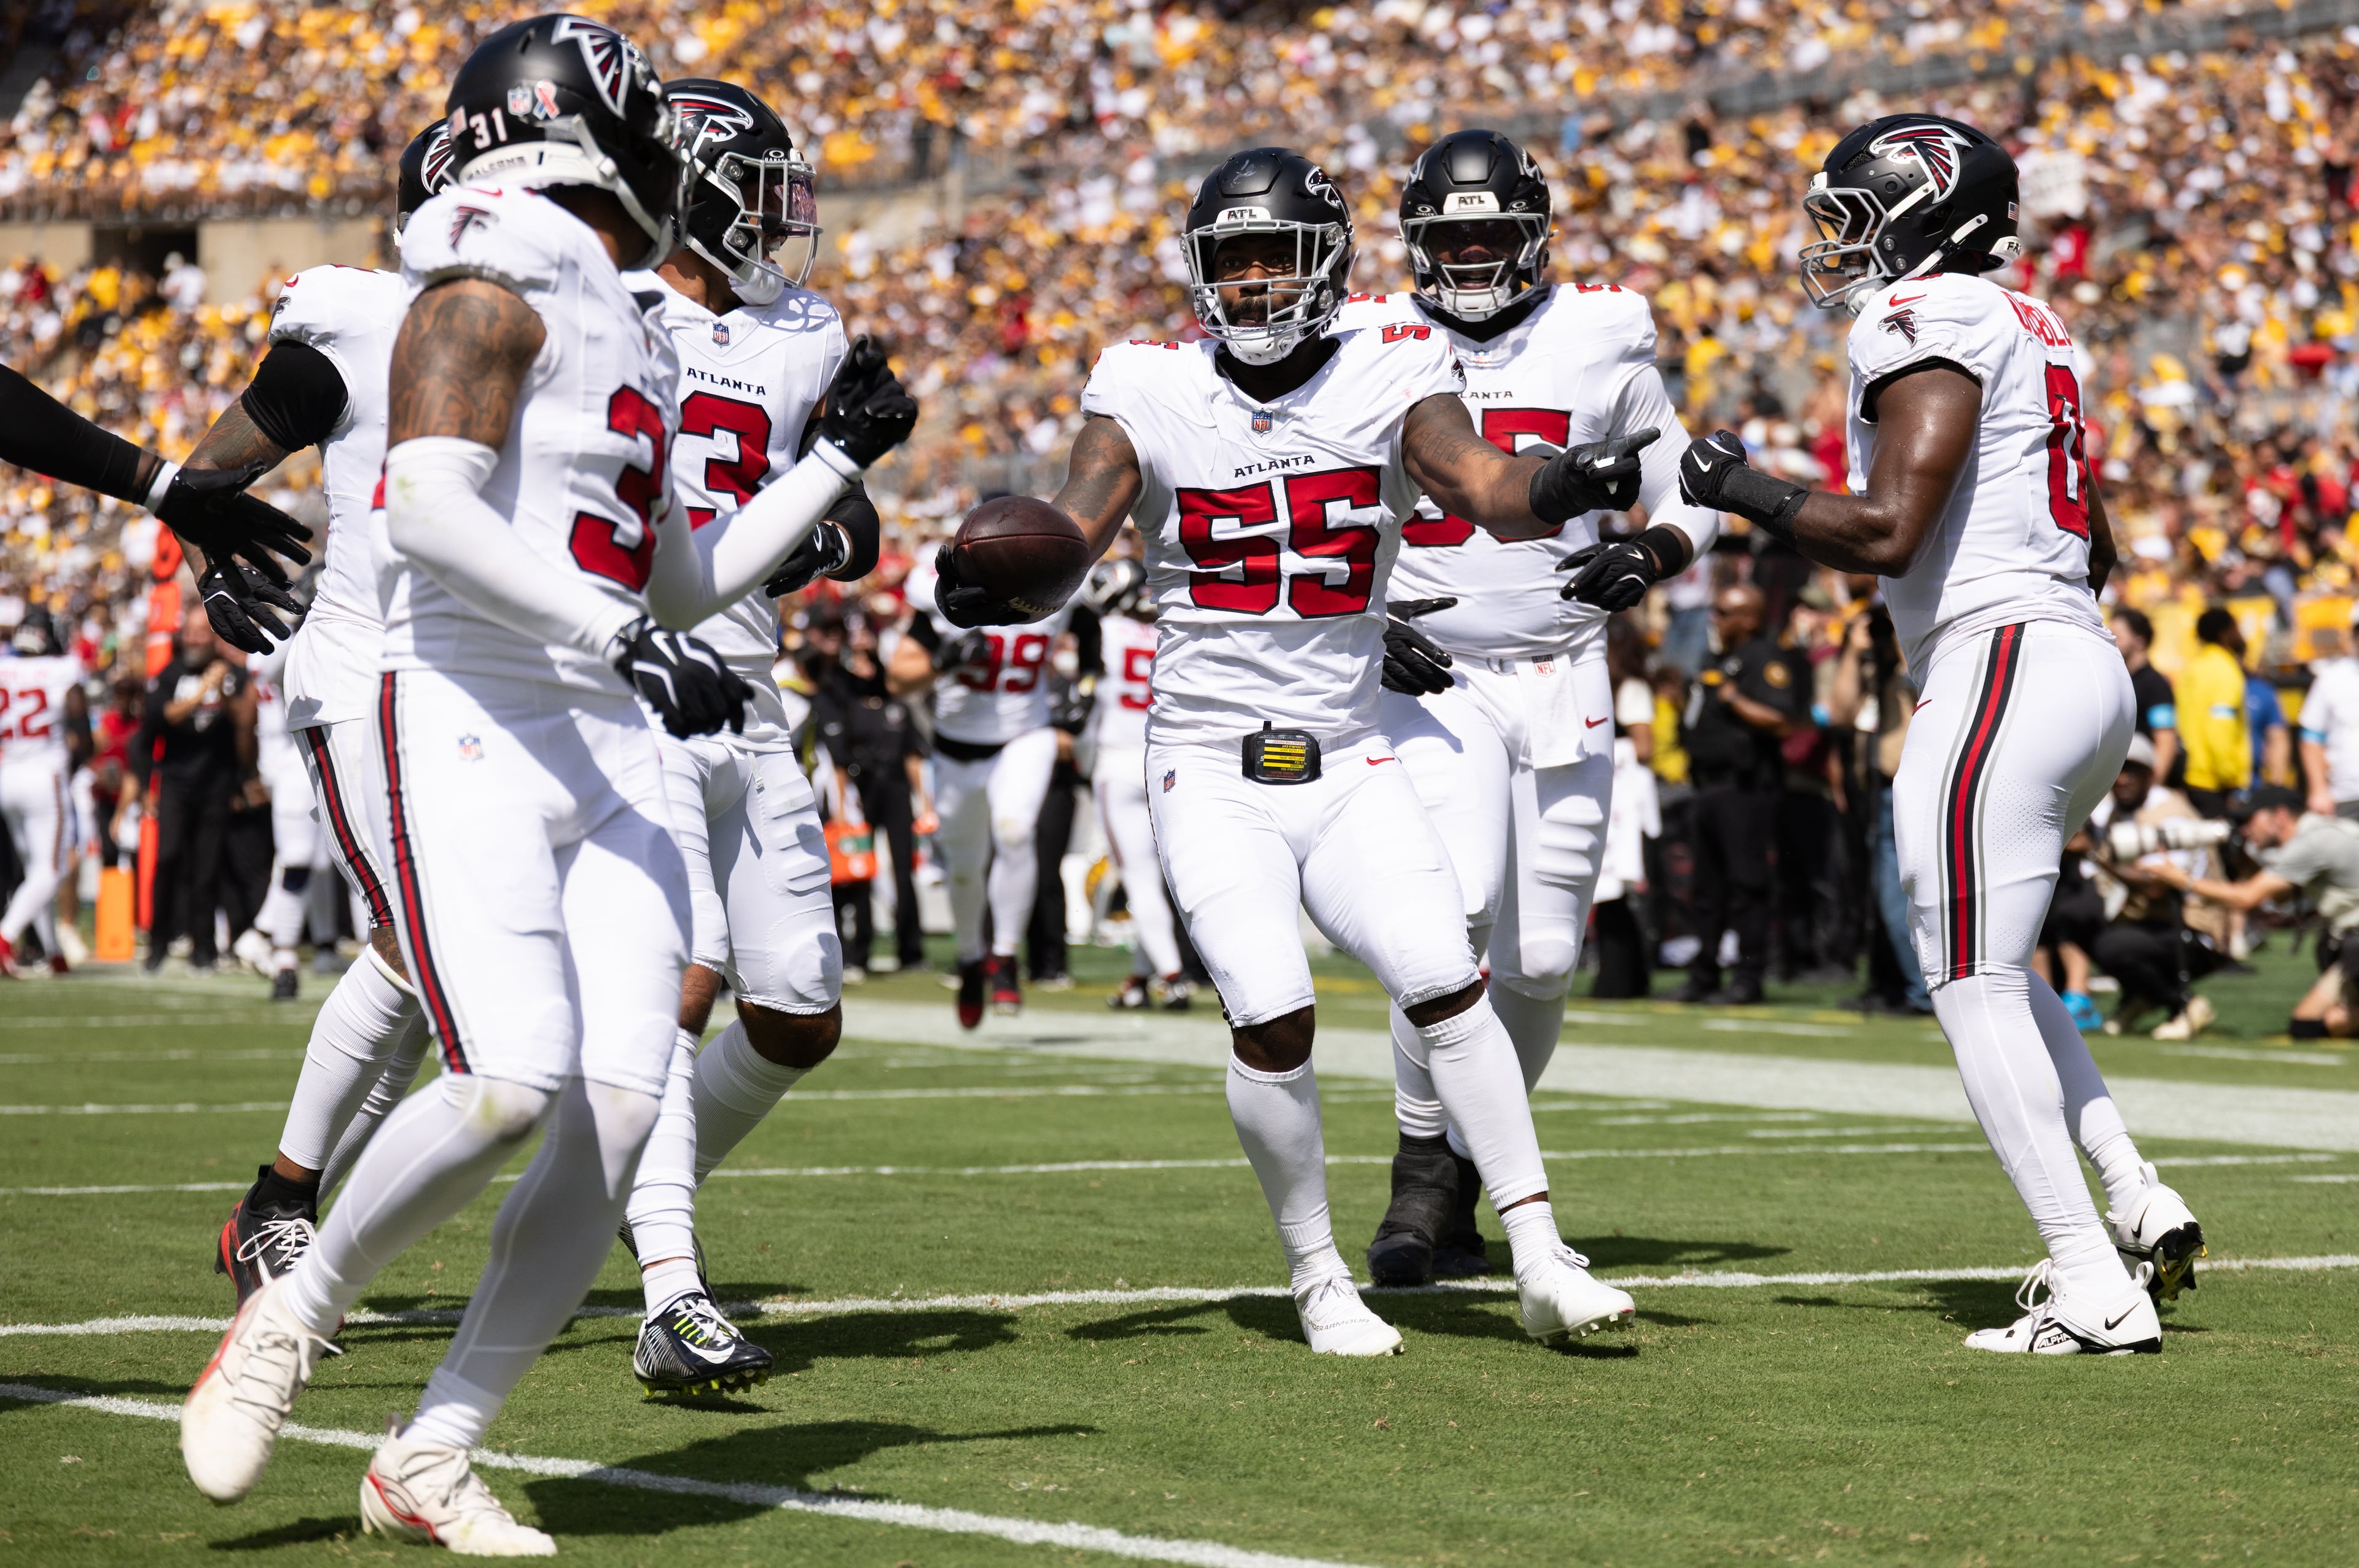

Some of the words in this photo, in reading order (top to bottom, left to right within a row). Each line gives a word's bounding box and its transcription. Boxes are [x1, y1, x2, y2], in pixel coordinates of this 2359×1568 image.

[469, 106, 508, 150] 31
[1457, 195, 1485, 209] ATL
[1227, 209, 1258, 221] ATL
[687, 367, 766, 396] ATLANTA
[1460, 391, 1513, 399] LANTA
[1254, 419, 1269, 431] NFL
[1234, 455, 1315, 478] ATLANTA
[569, 384, 665, 595] 3
[1175, 465, 1381, 619] 55
[1536, 663, 1554, 675] NFL
[2038, 1332, 2071, 1349] ALPHA
